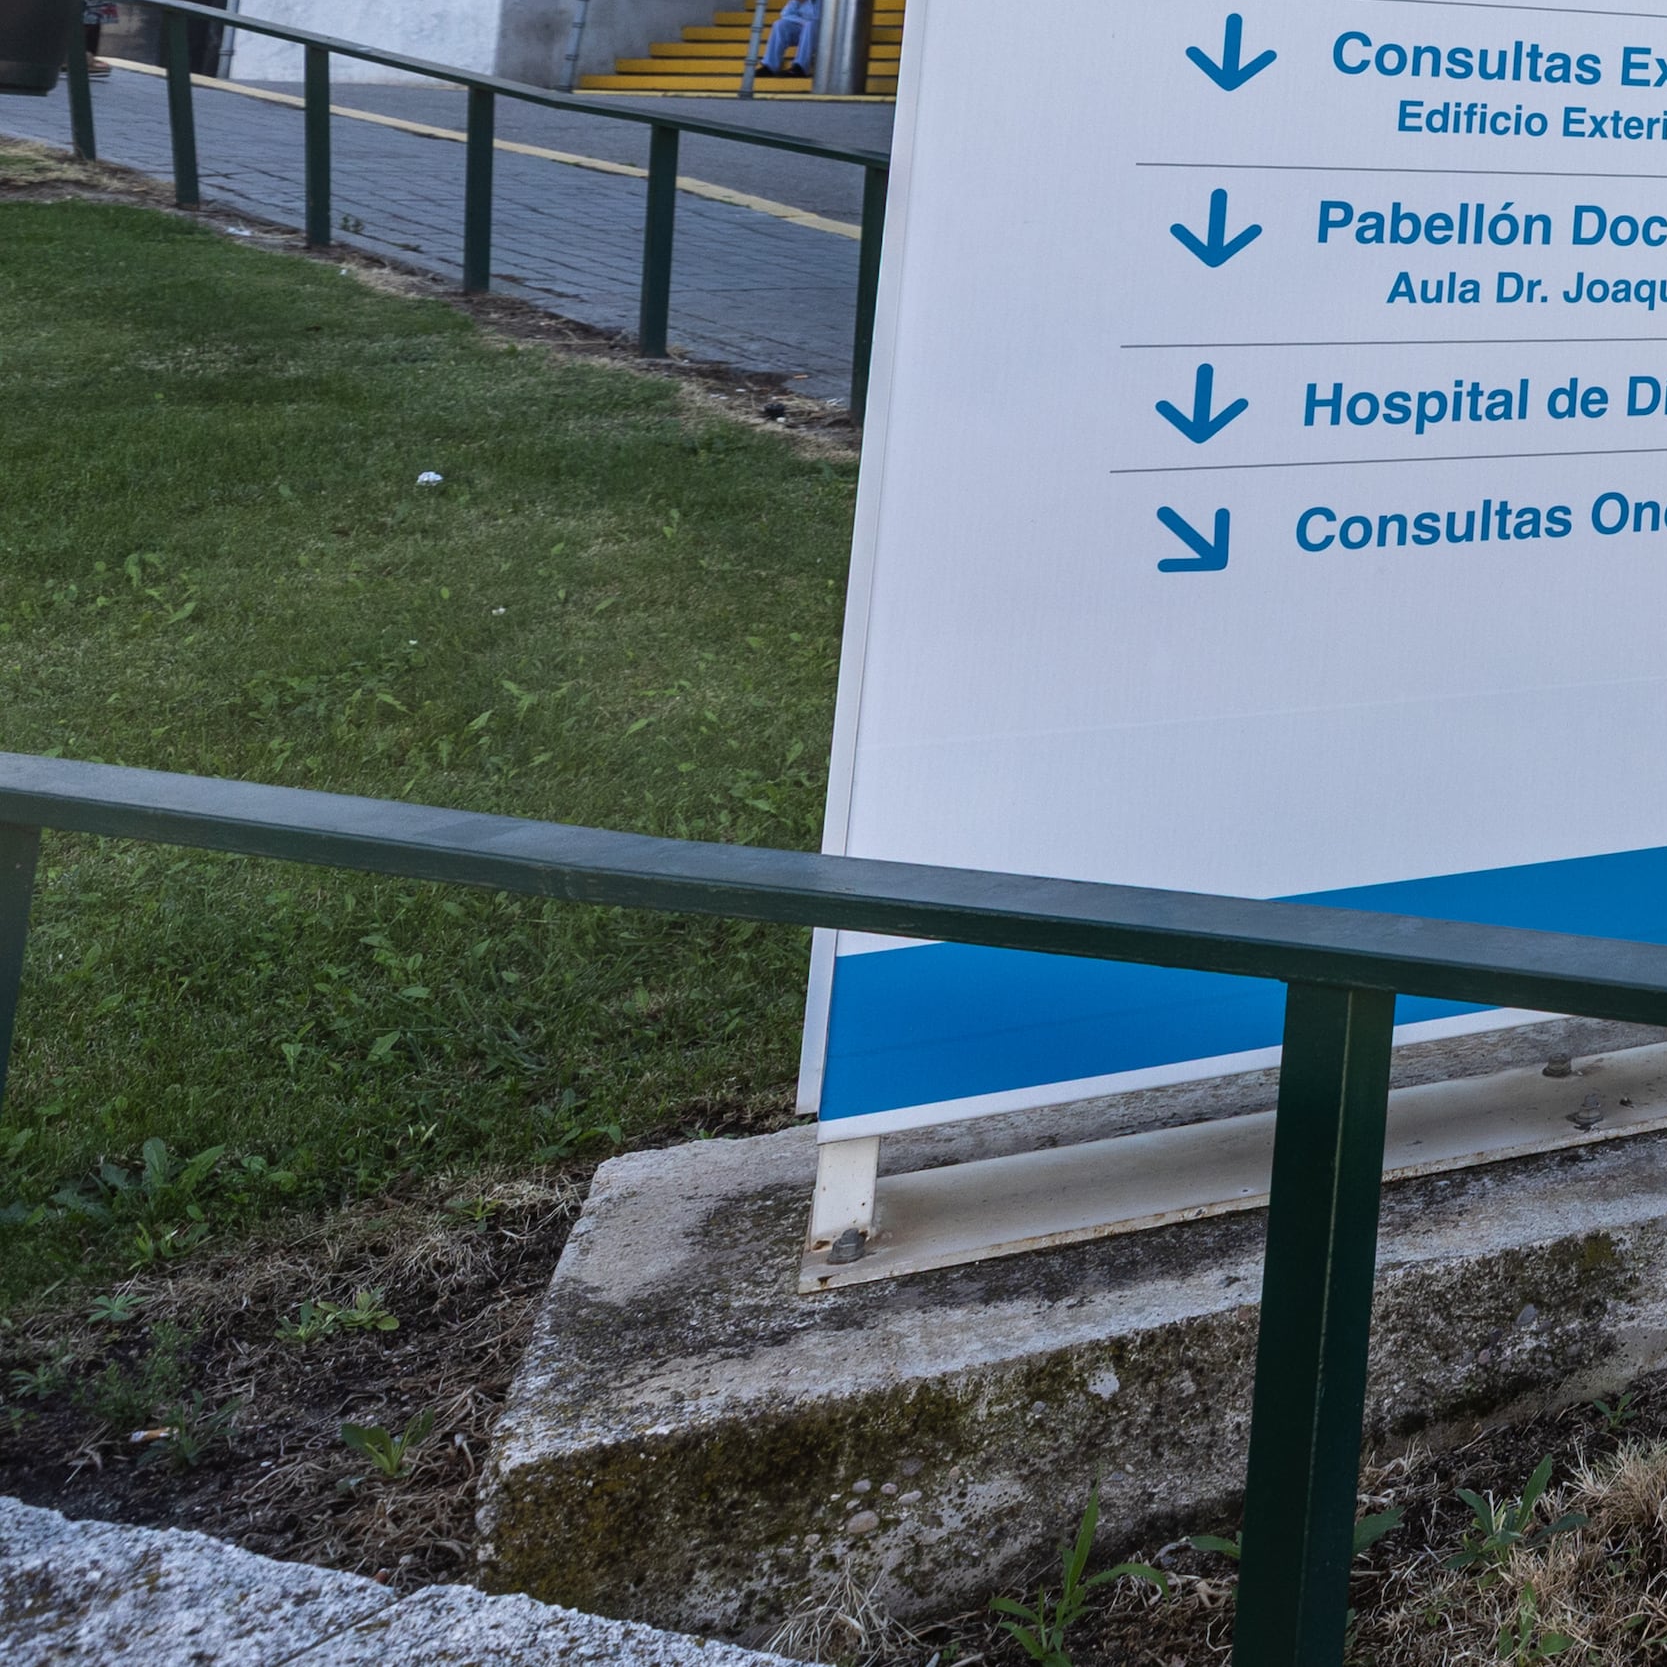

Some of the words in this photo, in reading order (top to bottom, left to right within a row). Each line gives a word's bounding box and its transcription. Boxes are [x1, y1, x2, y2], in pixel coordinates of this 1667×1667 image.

[1333, 31, 1601, 85] Consultas
[1398, 100, 1548, 137] Edificio
[1318, 200, 1552, 246] Pabellón
[1386, 271, 1480, 304] Aula
[1496, 272, 1549, 303] Dr.
[1304, 378, 1529, 435] Hospital
[1547, 377, 1608, 419] de
[1296, 499, 1572, 552] Consultas
